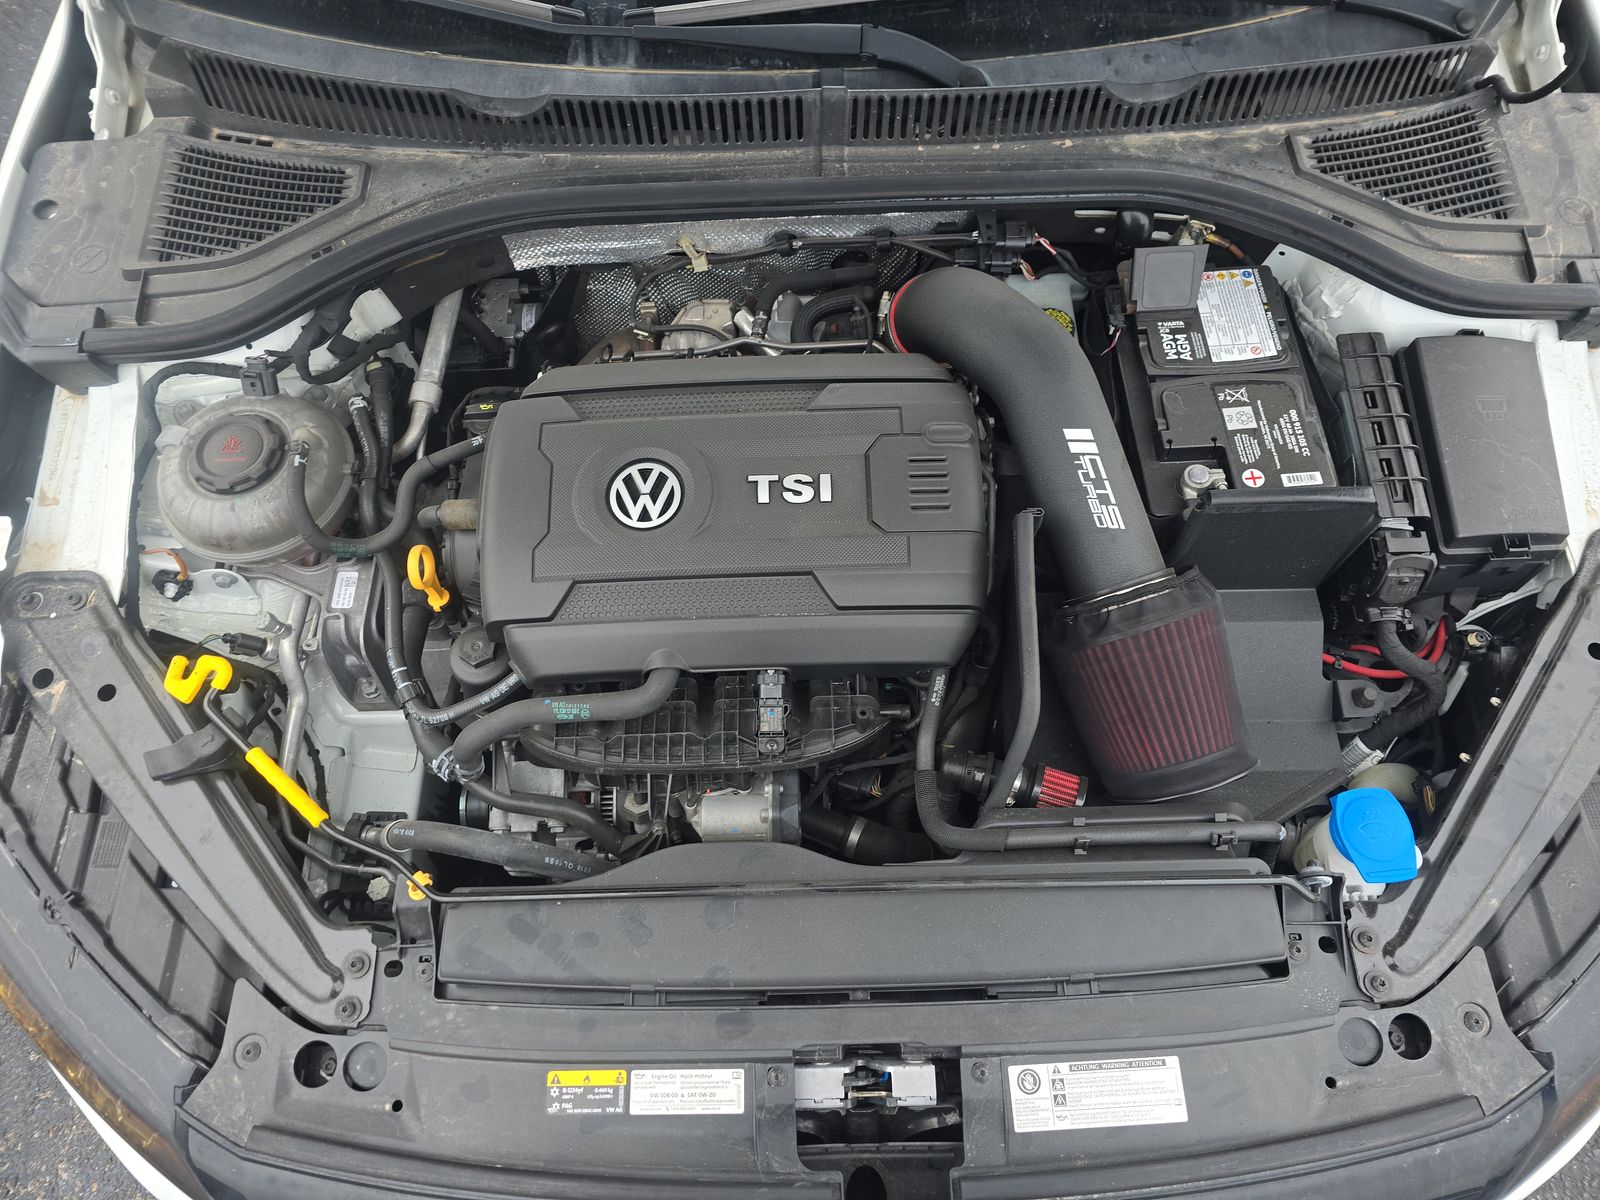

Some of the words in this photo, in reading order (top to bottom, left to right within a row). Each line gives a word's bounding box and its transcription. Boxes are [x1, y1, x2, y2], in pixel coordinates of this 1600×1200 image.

[1160, 334, 1178, 360] AGM
[1175, 334, 1193, 361] AGM
[1289, 409, 1299, 422] 000
[1294, 422, 1303, 434] 915
[1297, 434, 1306, 447] 105
[1302, 447, 1310, 456] CC
[609, 462, 681, 528] VW
[748, 473, 832, 504] TSI
[1074, 456, 1108, 528] TURBO
[1084, 455, 1125, 529] CTS
